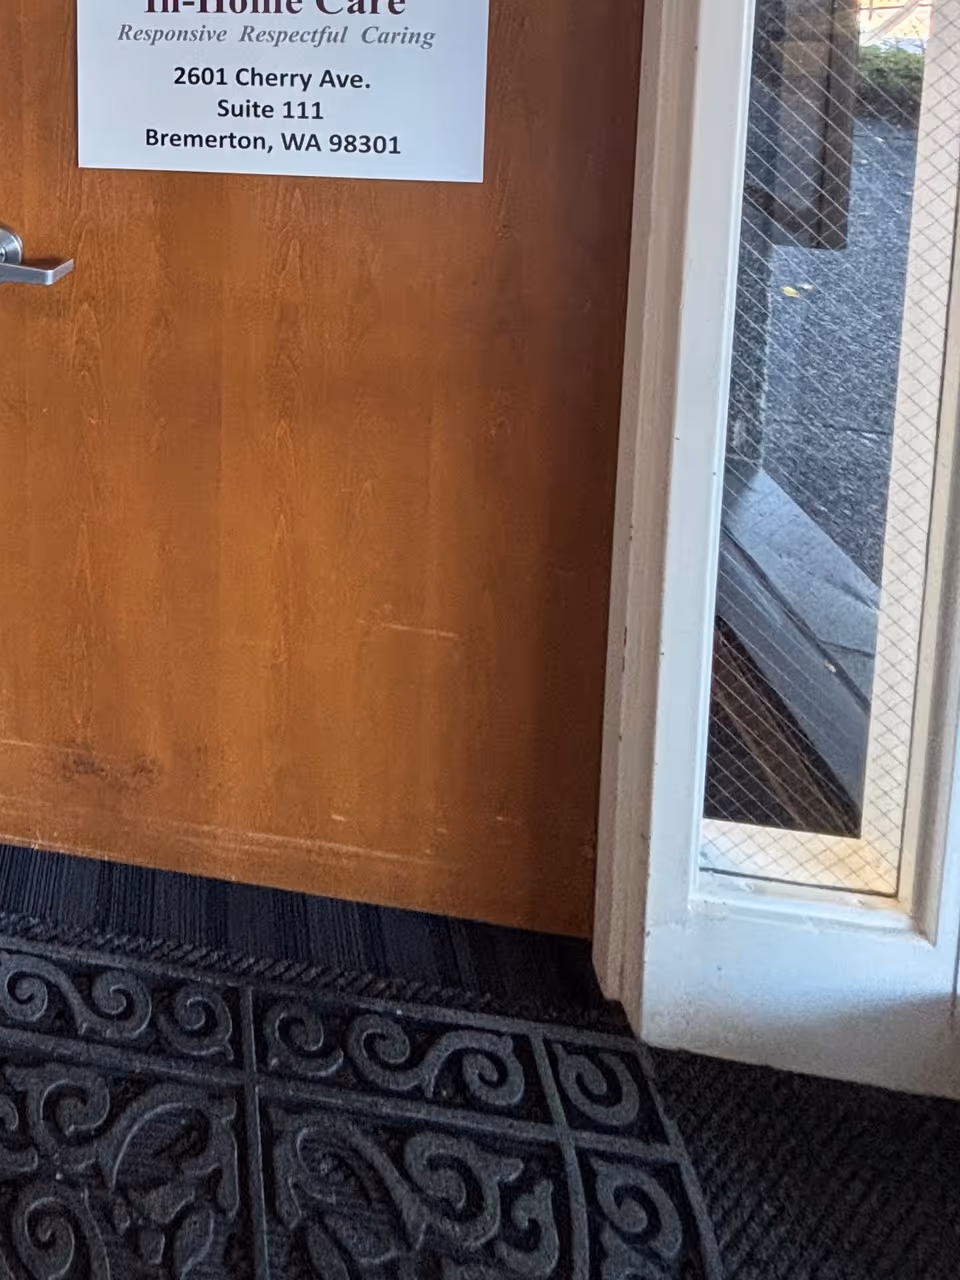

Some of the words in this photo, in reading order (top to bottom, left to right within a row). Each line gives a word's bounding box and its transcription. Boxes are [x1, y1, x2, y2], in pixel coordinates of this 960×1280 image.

[118, 24, 228, 46] Responsive
[239, 25, 346, 48] Respectful
[361, 26, 436, 49] Caring
[173, 67, 228, 87] 2601
[236, 67, 312, 92] Cherry
[319, 70, 371, 89] Ave.
[217, 100, 275, 120] Suite
[283, 101, 323, 121] 111
[145, 129, 273, 153] Bremerton,
[281, 134, 322, 152] WA
[329, 135, 401, 155] 98301
